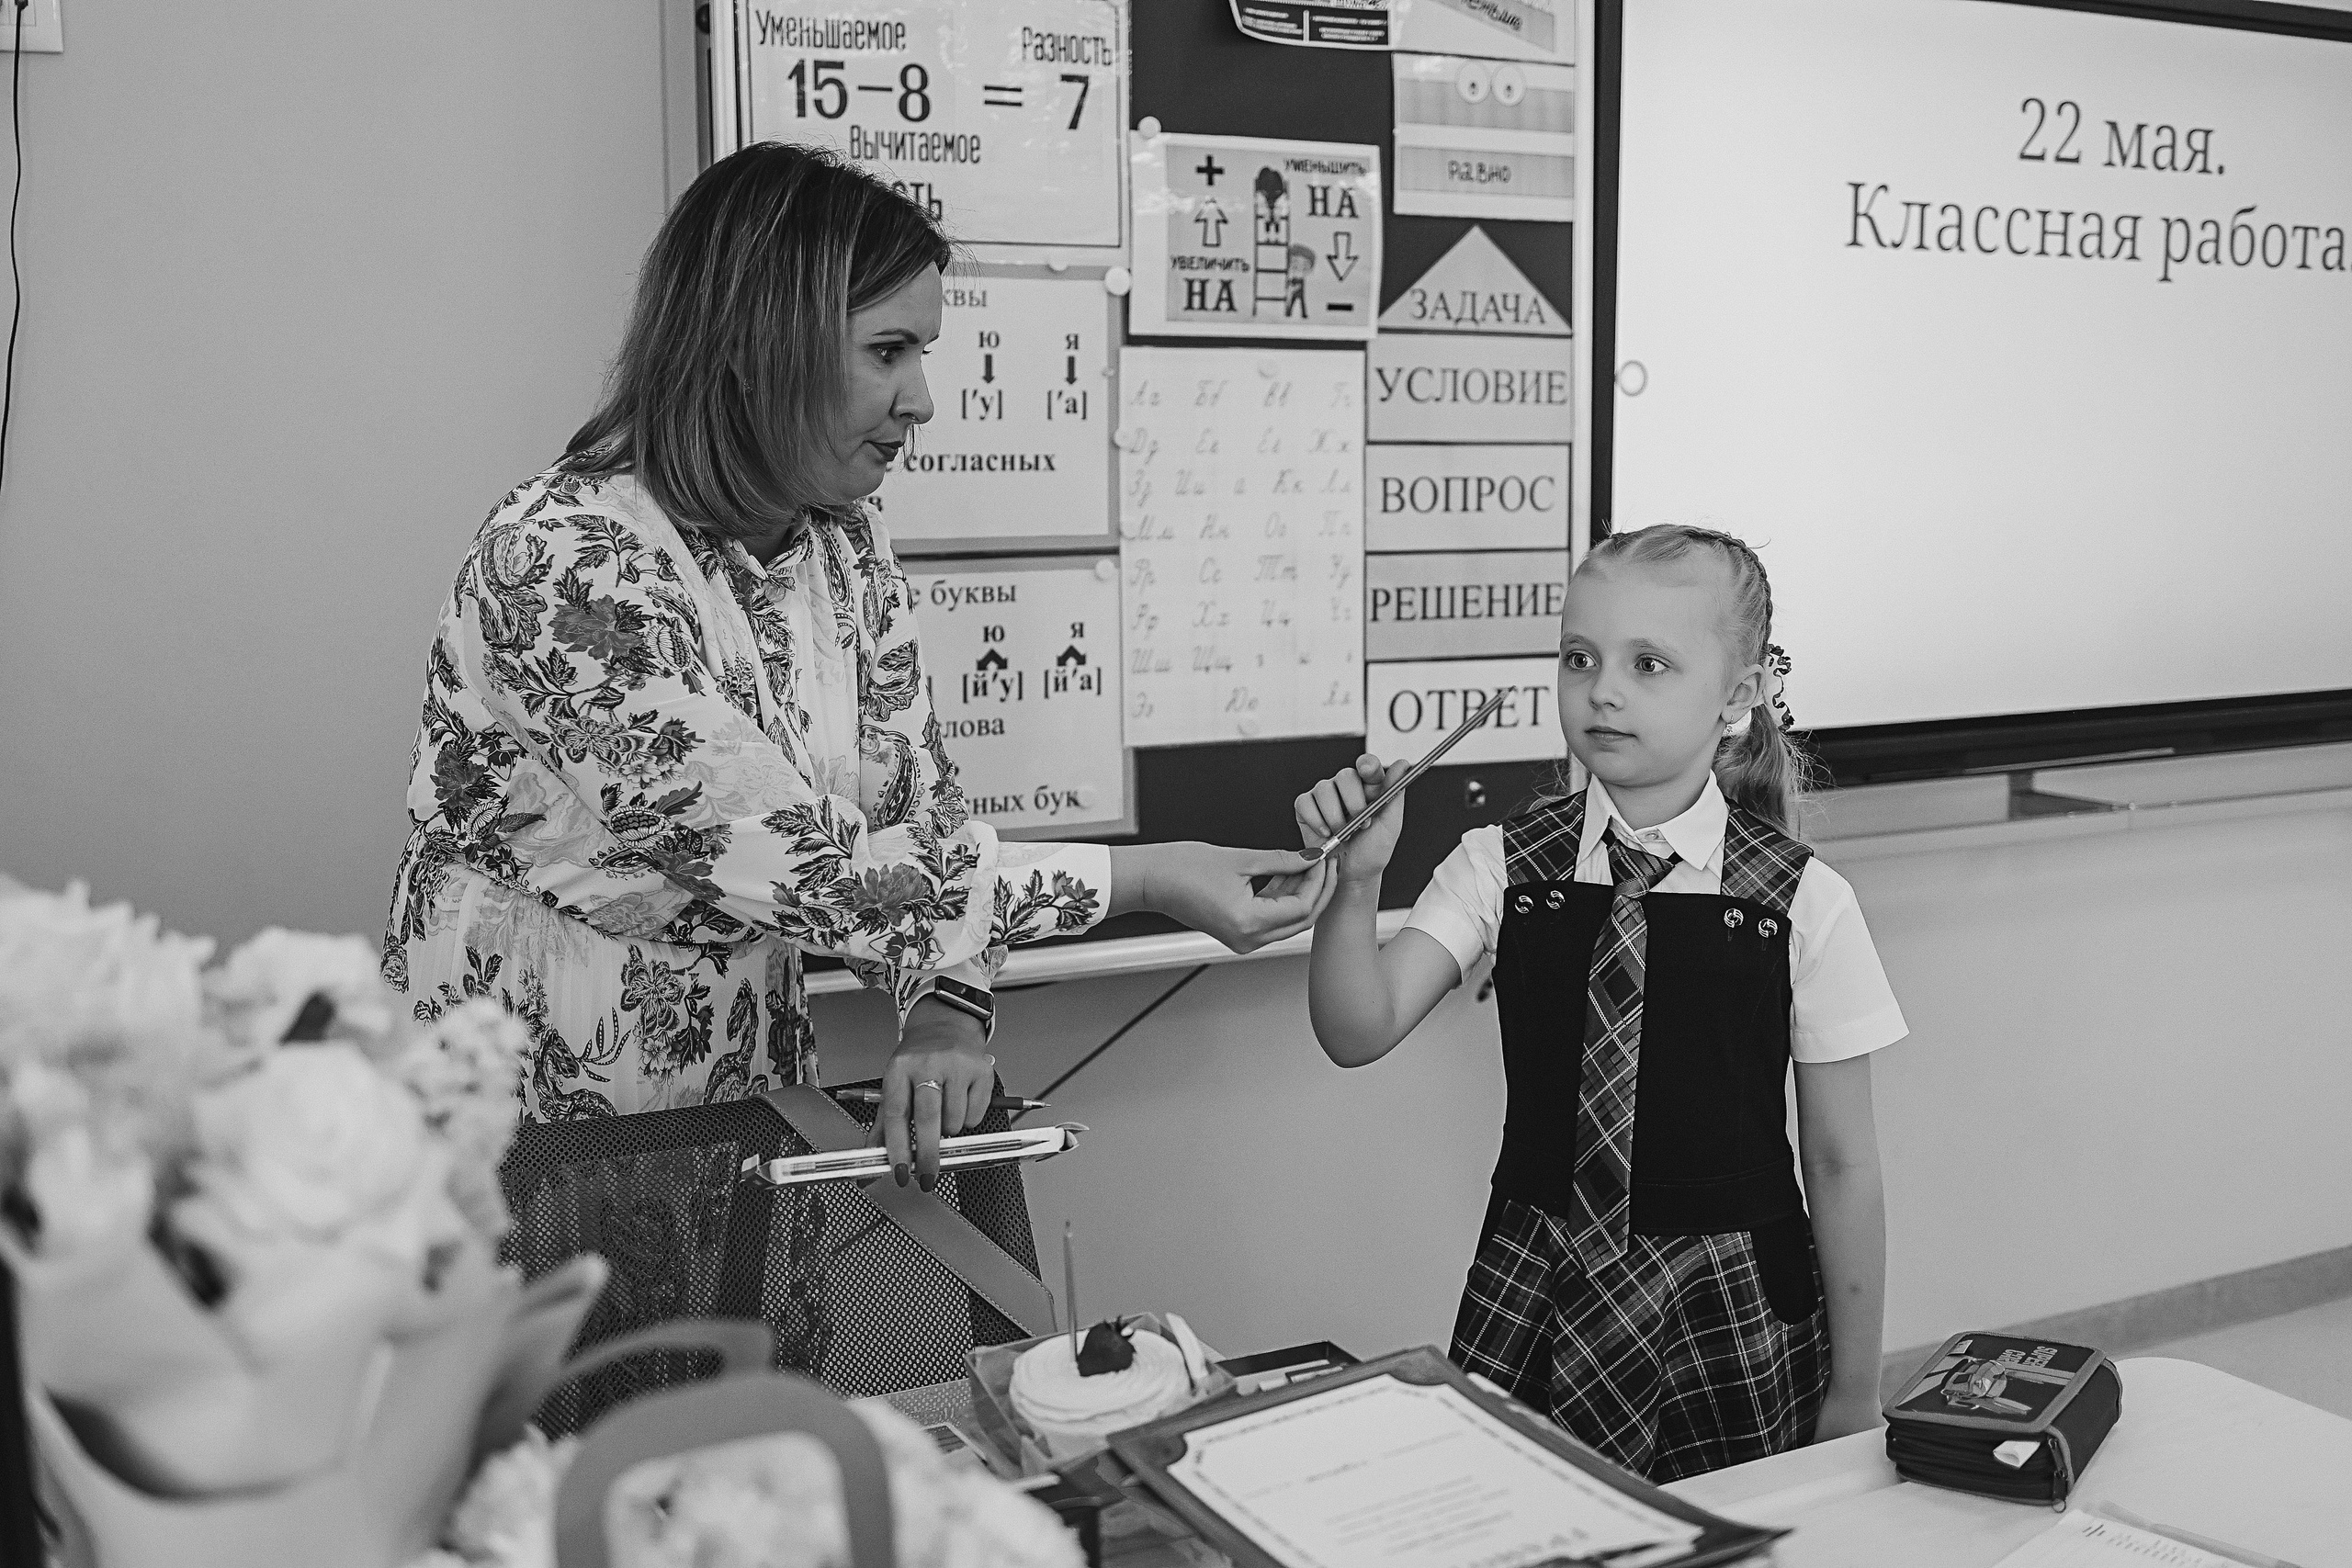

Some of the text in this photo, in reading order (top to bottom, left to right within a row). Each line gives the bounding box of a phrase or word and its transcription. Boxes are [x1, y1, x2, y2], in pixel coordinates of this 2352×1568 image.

[755, 10, 907, 50] Уменьшаемое
[1022, 26, 1114, 65] Разность
[1059, 73, 1090, 130] 7
[850, 124, 981, 164] Вычитаемое
[2018, 97, 2226, 175] 22 мая.
[1307, 184, 1359, 218] НА
[1846, 182, 2352, 282] Классная работа
[1184, 278, 1237, 311] НА
[1409, 288, 1546, 326] ЗАДАЧА
[978, 330, 1080, 351] ю я
[1375, 367, 1568, 405] УСЛОВИЕ
[906, 452, 1056, 472] согласных
[1380, 476, 1555, 513] ВОПРОС
[931, 579, 1016, 612] буквы
[1370, 582, 1565, 624] РЕШЕНИЕ
[983, 621, 1084, 643] ю я
[939, 716, 1005, 739] лова
[1389, 686, 1550, 733] ОТВЕТ
[1034, 784, 1080, 816] бук
